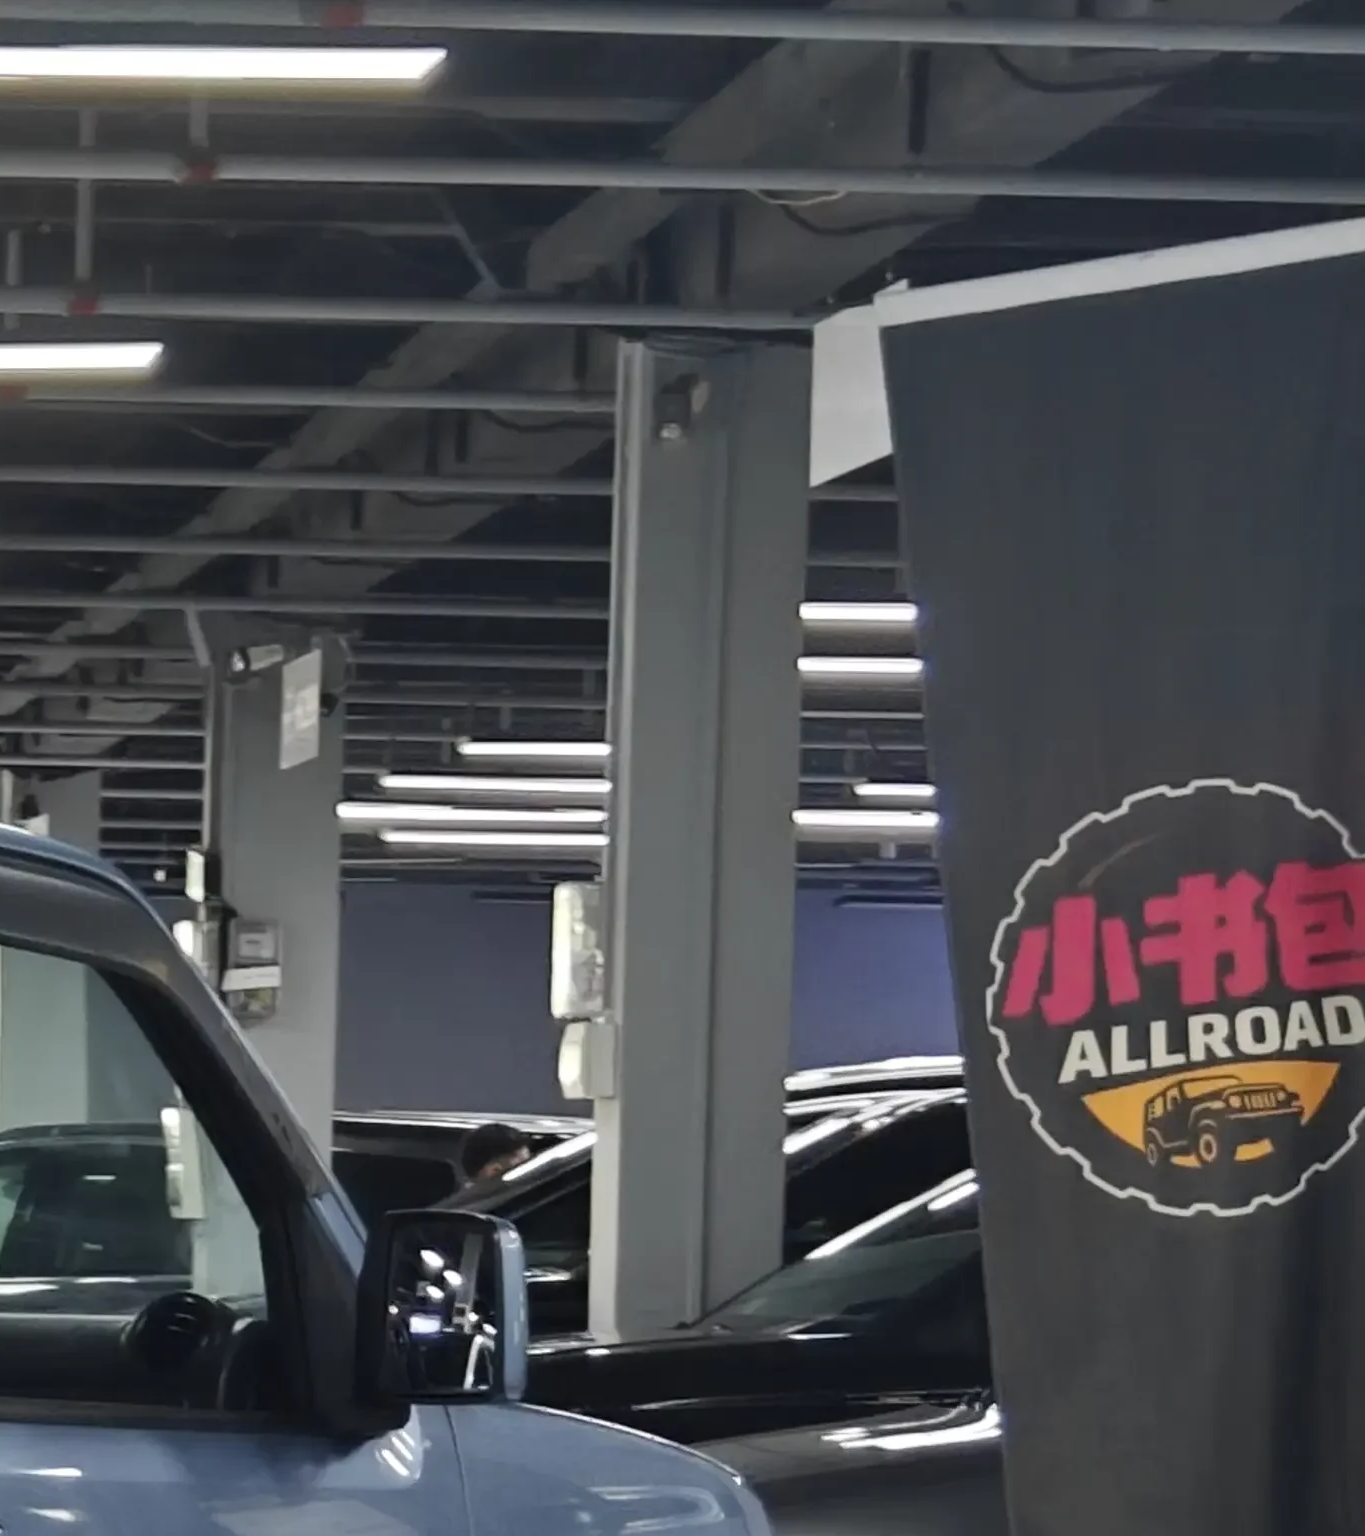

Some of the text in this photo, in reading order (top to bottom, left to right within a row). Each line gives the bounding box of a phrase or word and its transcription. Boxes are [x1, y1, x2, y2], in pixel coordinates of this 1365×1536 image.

[1002, 860, 1365, 1026] 小书包
[1058, 994, 1365, 1084] ALLROAD
